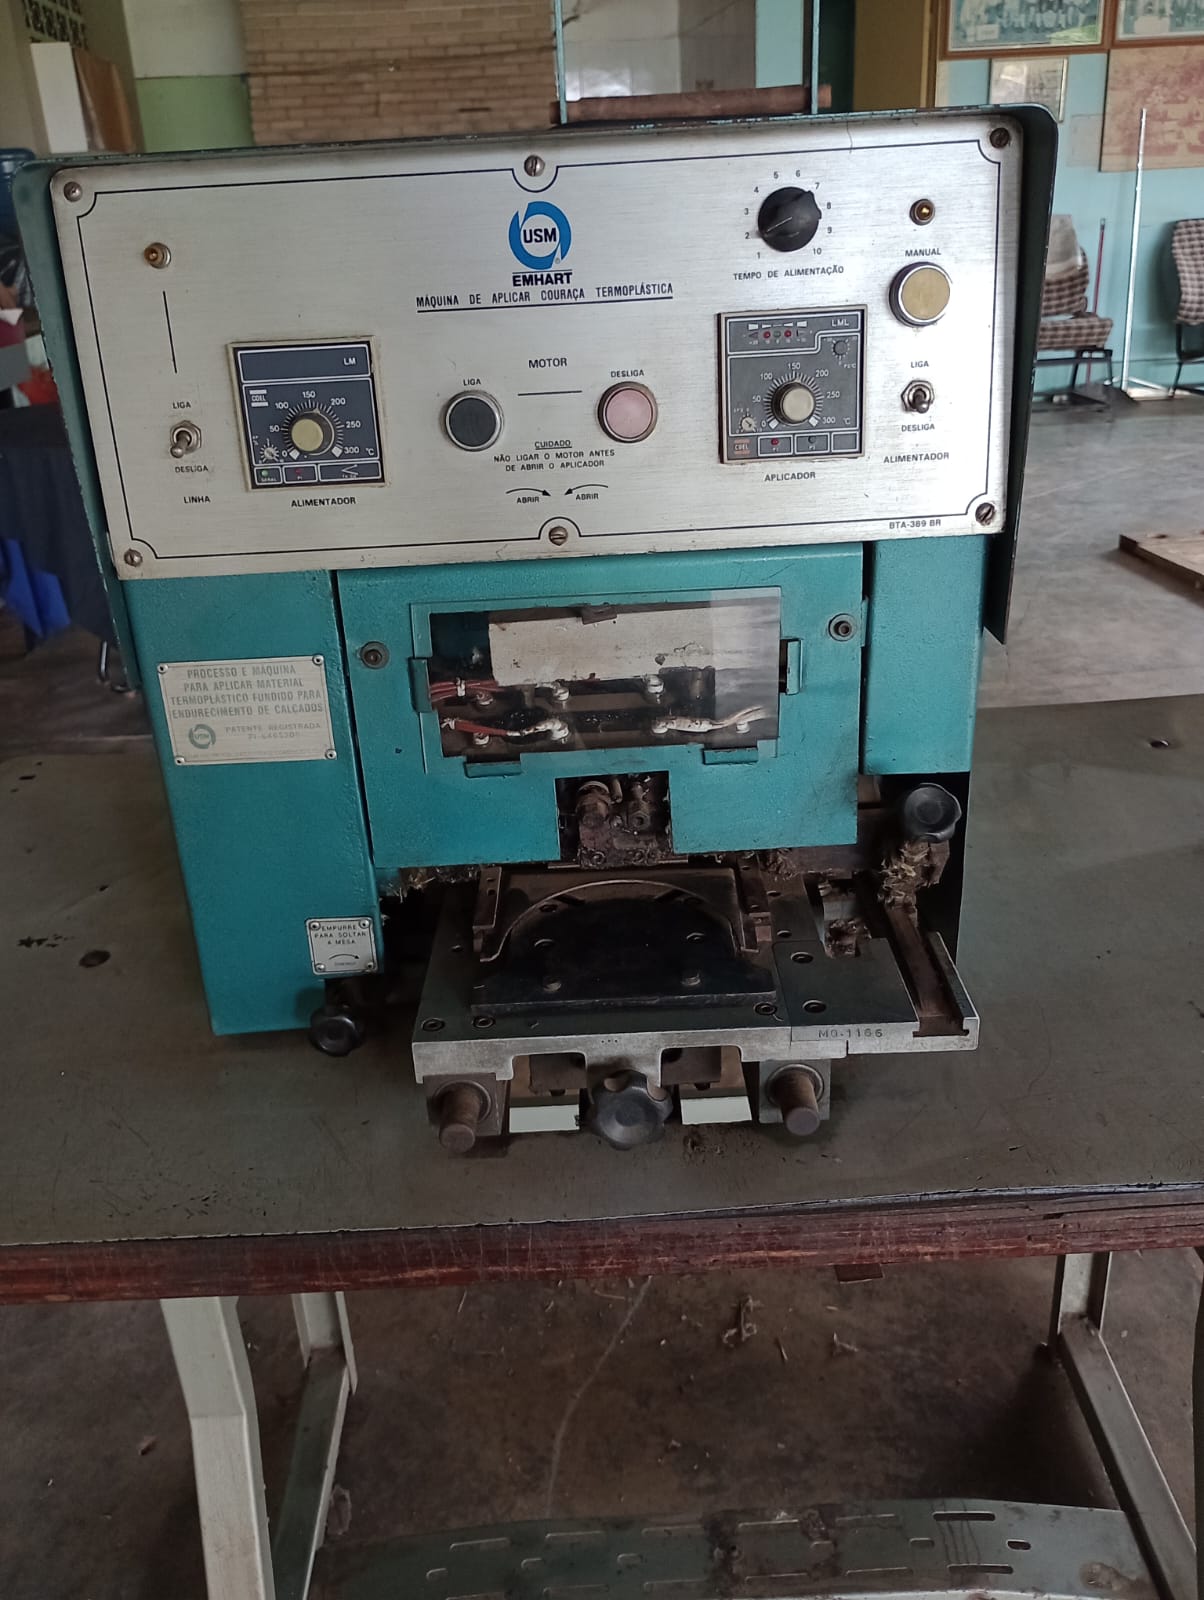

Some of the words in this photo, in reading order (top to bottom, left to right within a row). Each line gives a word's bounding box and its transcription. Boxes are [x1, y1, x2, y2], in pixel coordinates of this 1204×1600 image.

[773, 171, 779, 179] 5
[795, 170, 801, 178] 6
[753, 186, 759, 194] 4
[815, 182, 820, 190] 7
[826, 202, 832, 210] 8
[744, 208, 749, 216] 3
[523, 228, 557, 243] USM
[745, 232, 750, 240] 2
[905, 248, 942, 257] MANUAL
[733, 272, 762, 280] TEMPO
[767, 270, 779, 278] DE
[784, 265, 845, 276] ALIMENTAÇÃO
[512, 272, 573, 287] EMHART
[416, 295, 459, 309] MÁQUINA
[469, 294, 482, 305] DE
[492, 292, 531, 304] APLICAR
[541, 289, 585, 302] COURAÇA
[595, 283, 673, 298] TERMOPLÁSTICA
[831, 319, 850, 327] LML
[343, 357, 357, 366] LM
[528, 358, 568, 369] MOTOR
[911, 361, 930, 369] LIGA
[610, 370, 645, 378] DESLIGA
[760, 373, 773, 381] 100
[815, 370, 829, 378] 200
[463, 378, 482, 386] LIGA
[302, 391, 316, 399] 150
[752, 395, 761, 403] 50
[826, 391, 840, 399] 250
[172, 401, 192, 410] LIGA
[275, 402, 289, 410] 100
[331, 398, 346, 406] 200
[346, 420, 361, 429] 250
[901, 424, 935, 433] DESLIGA
[269, 425, 280, 433] 50
[534, 440, 571, 448] CUIDADO
[493, 453, 511, 463] NÃO
[516, 453, 539, 462] LIGAR
[555, 451, 584, 459] MOTOR
[589, 449, 615, 457] ANTES
[883, 452, 949, 463] ALIMENTADOR
[174, 465, 209, 473] DESLIGA
[505, 464, 516, 472] DE
[520, 463, 544, 471] ABRIR
[549, 462, 555, 470] O
[560, 460, 605, 469] APLICADOR
[764, 471, 816, 482] APLICADOR
[183, 495, 211, 504] LINHA
[516, 496, 540, 504] ABRIR
[575, 493, 599, 501] ABRIR
[291, 497, 356, 507] ALIMENTADOR
[889, 520, 927, 529] BTA-389
[929, 519, 941, 527] BR
[187, 667, 238, 679] PROCESSO
[242, 667, 247, 676] E
[183, 682, 209, 692] PARA
[213, 680, 252, 691] APLICAR
[257, 678, 304, 689] MATERIAL
[252, 691, 294, 702] FUNDIDO
[297, 690, 321, 700] PARA
[172, 706, 253, 719] ENDURECIMENTO
[257, 705, 271, 715] DE
[225, 725, 263, 733] PATENTE
[268, 722, 321, 731] REGISTRADA
